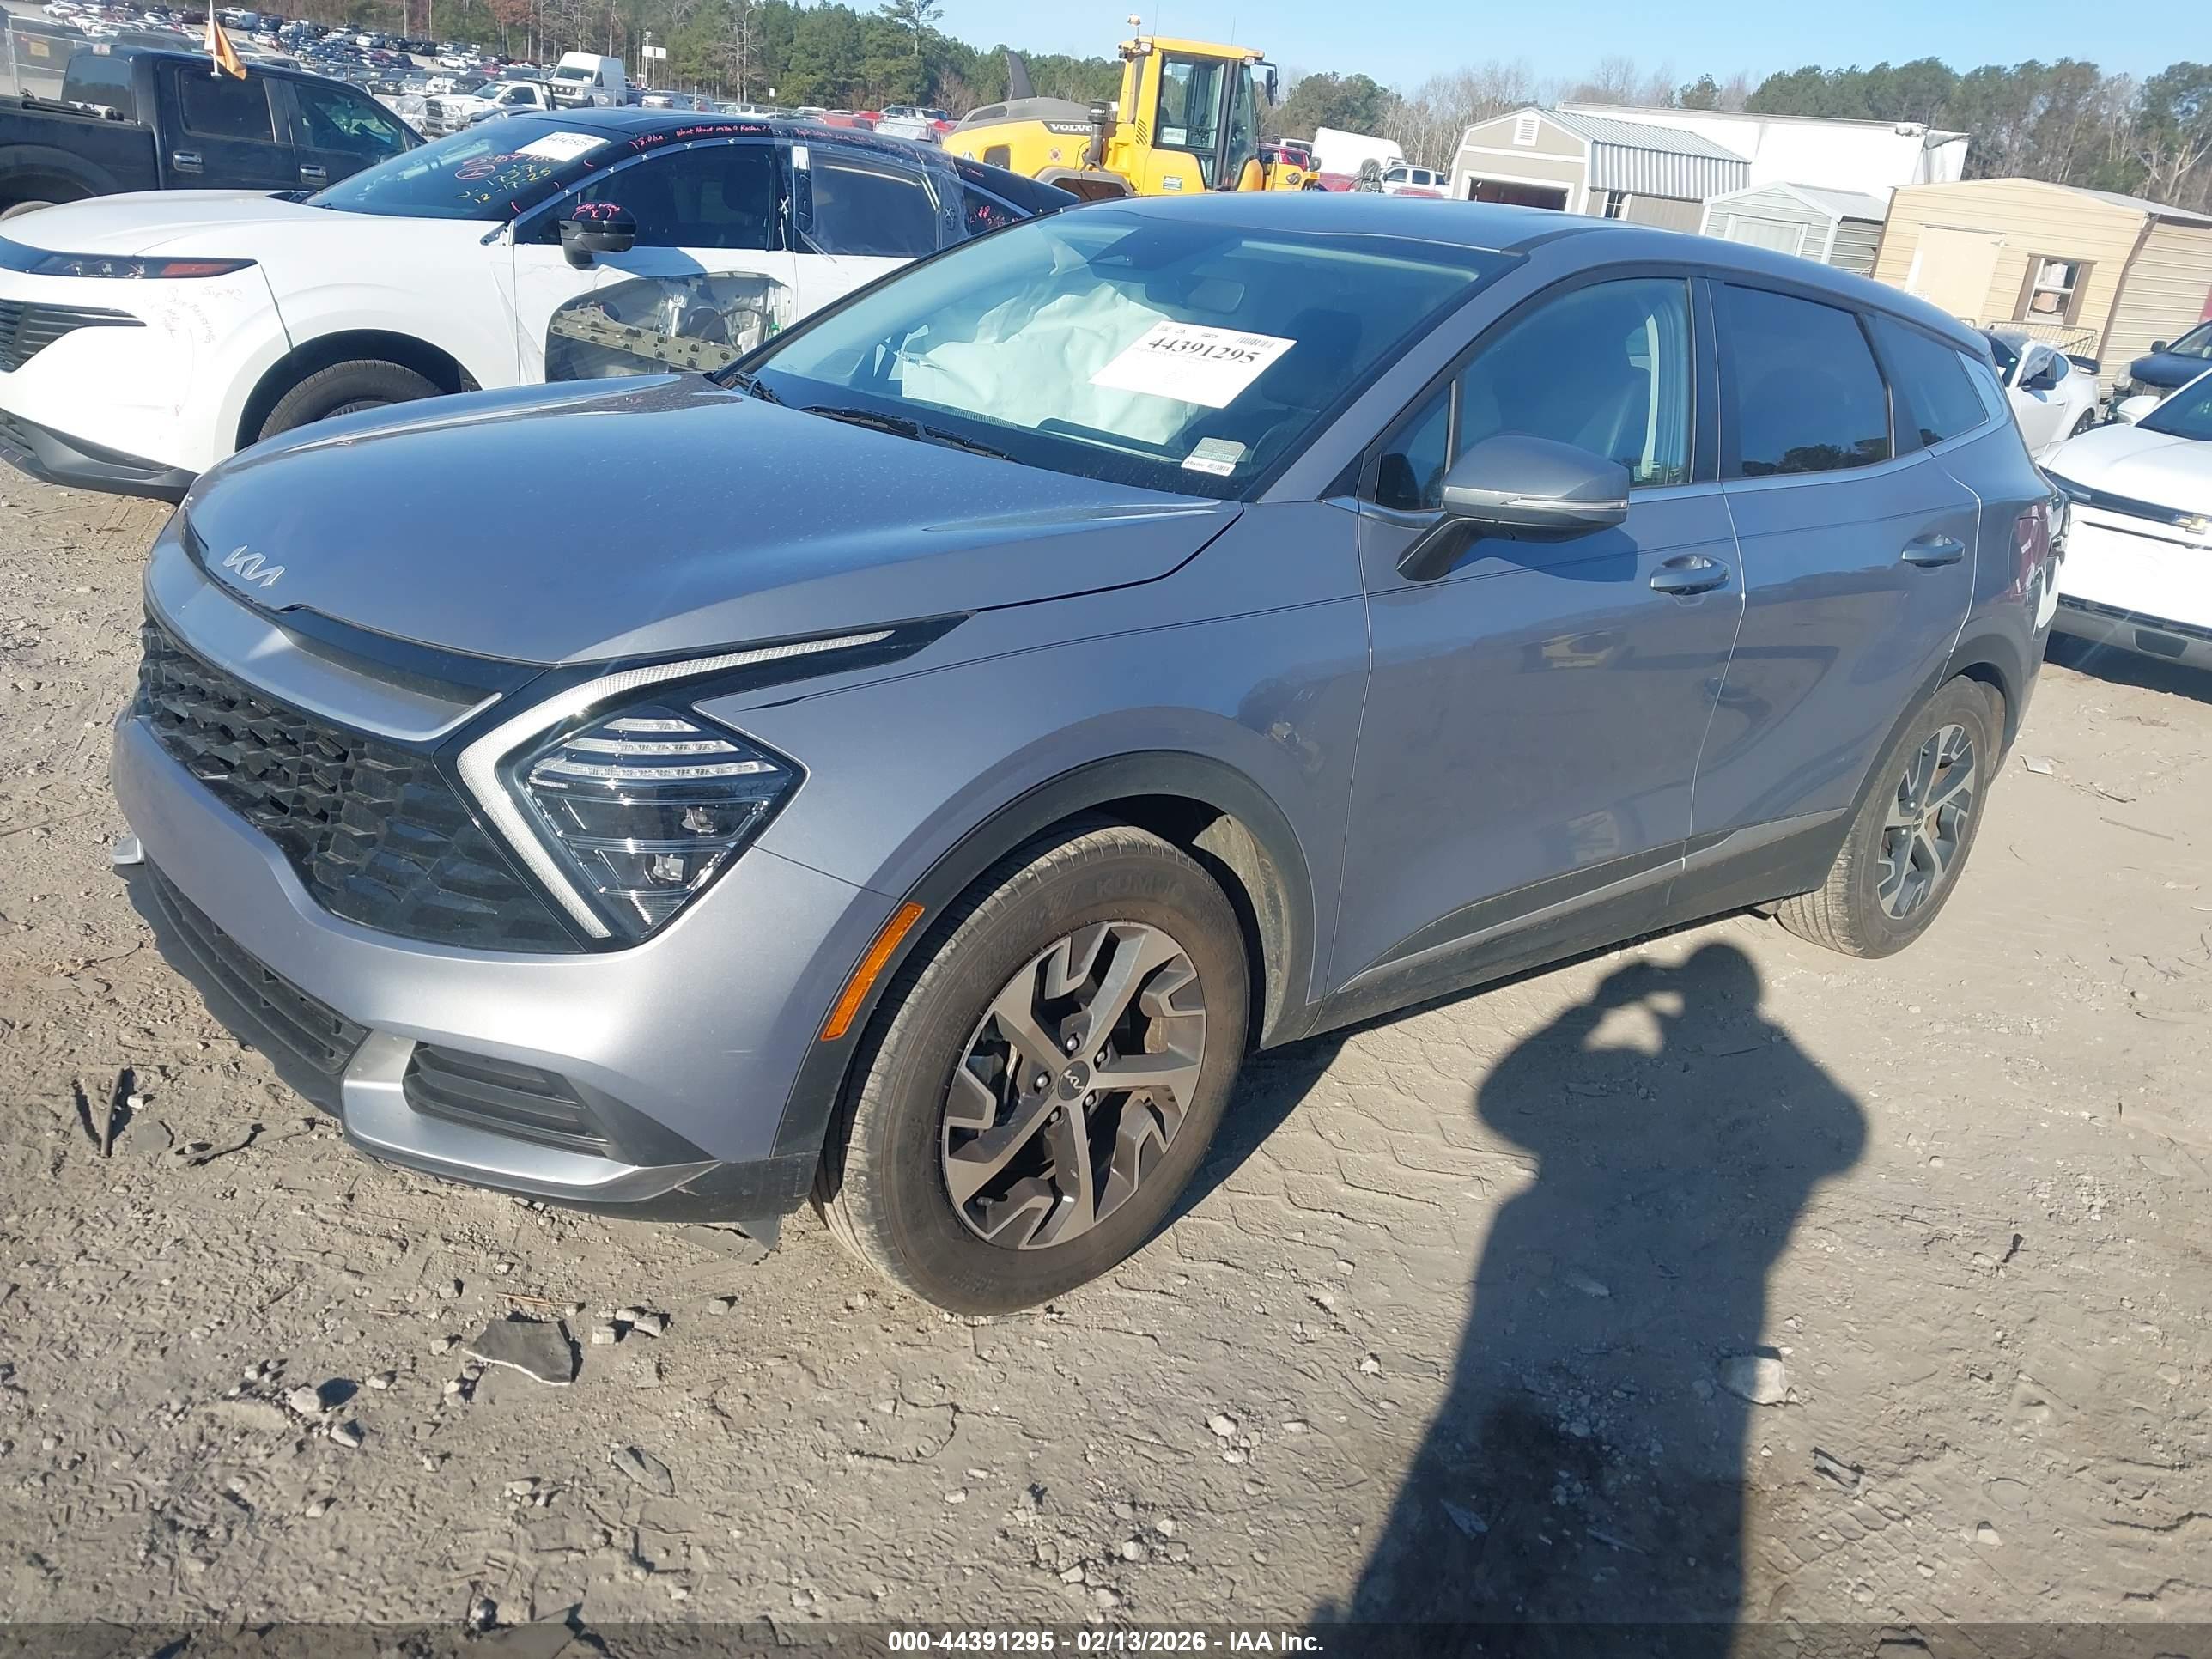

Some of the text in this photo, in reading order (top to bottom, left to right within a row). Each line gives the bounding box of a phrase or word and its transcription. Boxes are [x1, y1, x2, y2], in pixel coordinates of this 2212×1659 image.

[1049, 123, 1093, 131] VOLVO
[1148, 337, 1261, 364] 44391295
[222, 544, 286, 588] KIA
